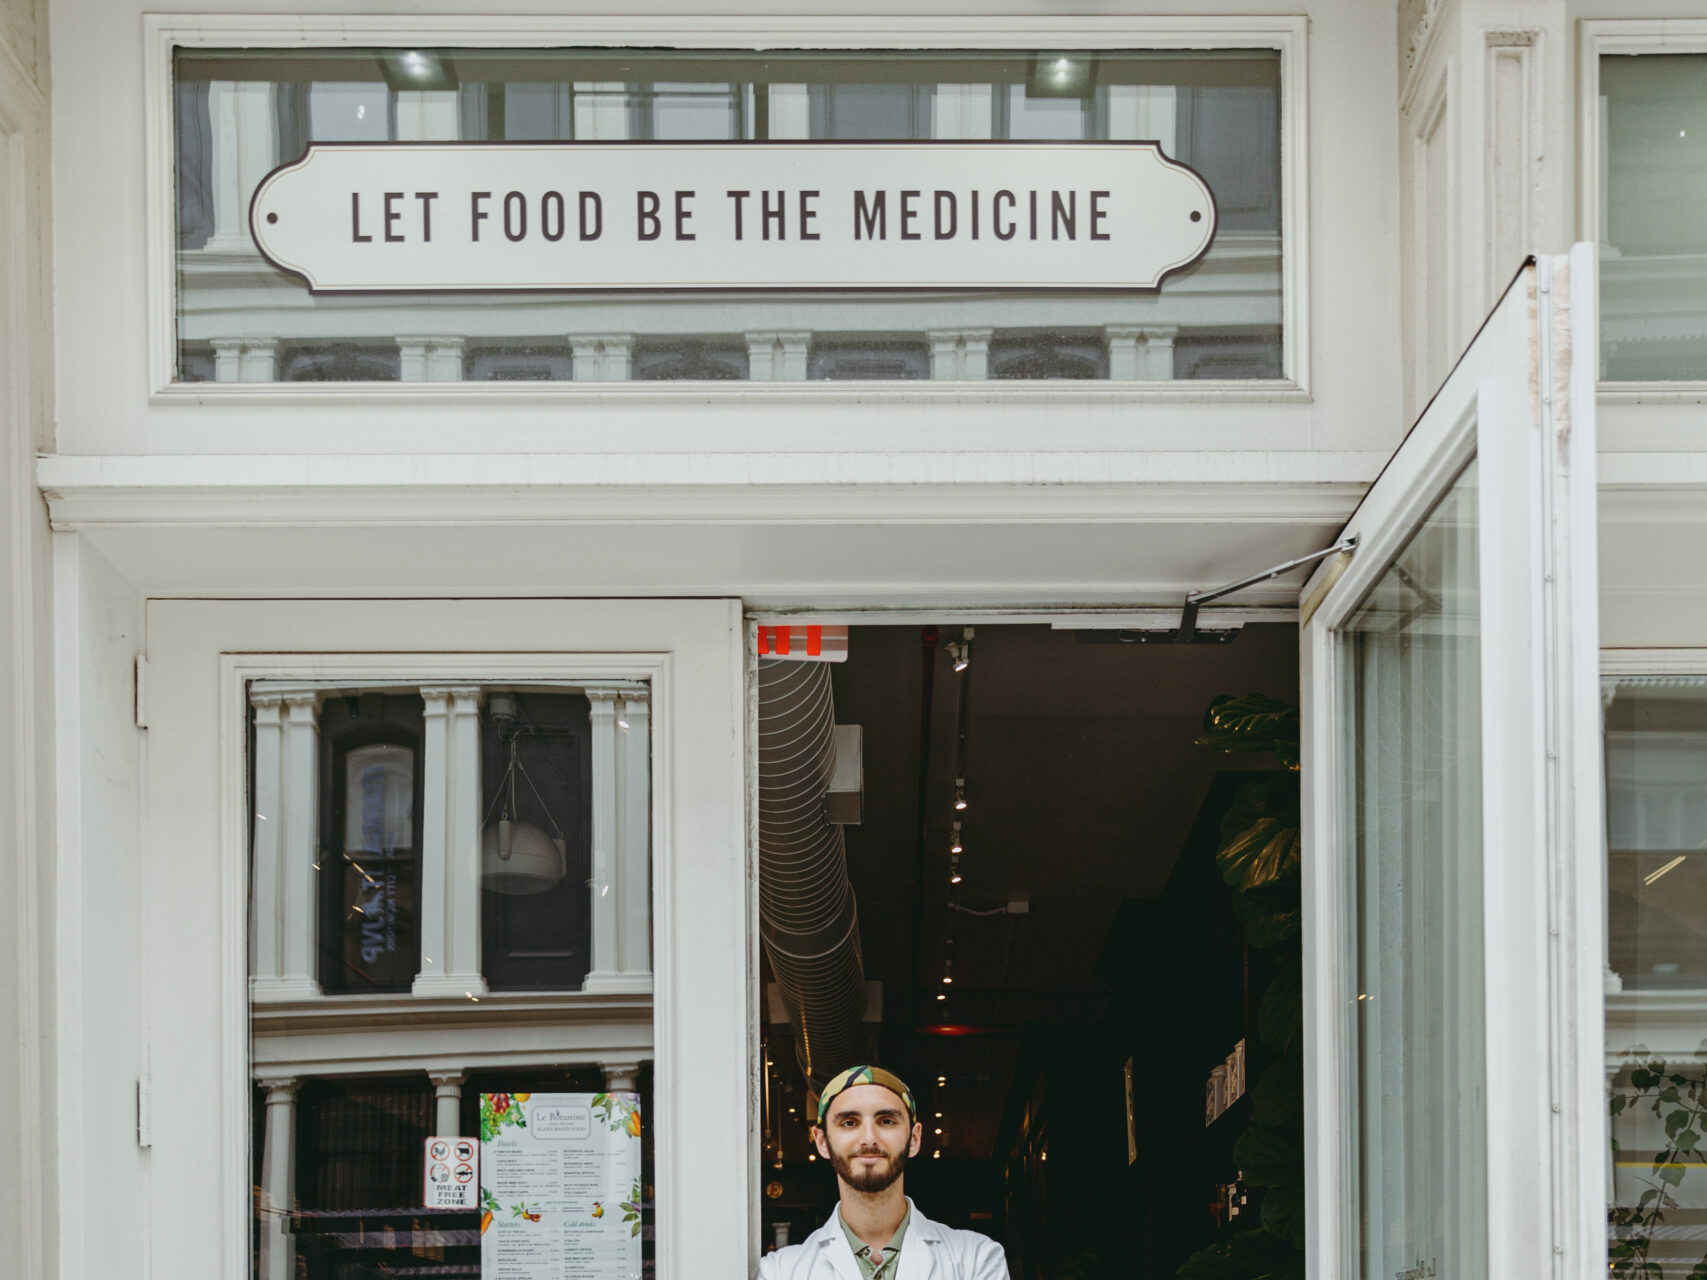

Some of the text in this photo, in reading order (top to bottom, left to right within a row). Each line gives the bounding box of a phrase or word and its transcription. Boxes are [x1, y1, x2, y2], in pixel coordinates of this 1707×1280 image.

[351, 189, 1111, 243] LET FOOD BE THE MEDICINE
[537, 1110, 587, 1121] Le Botaniste
